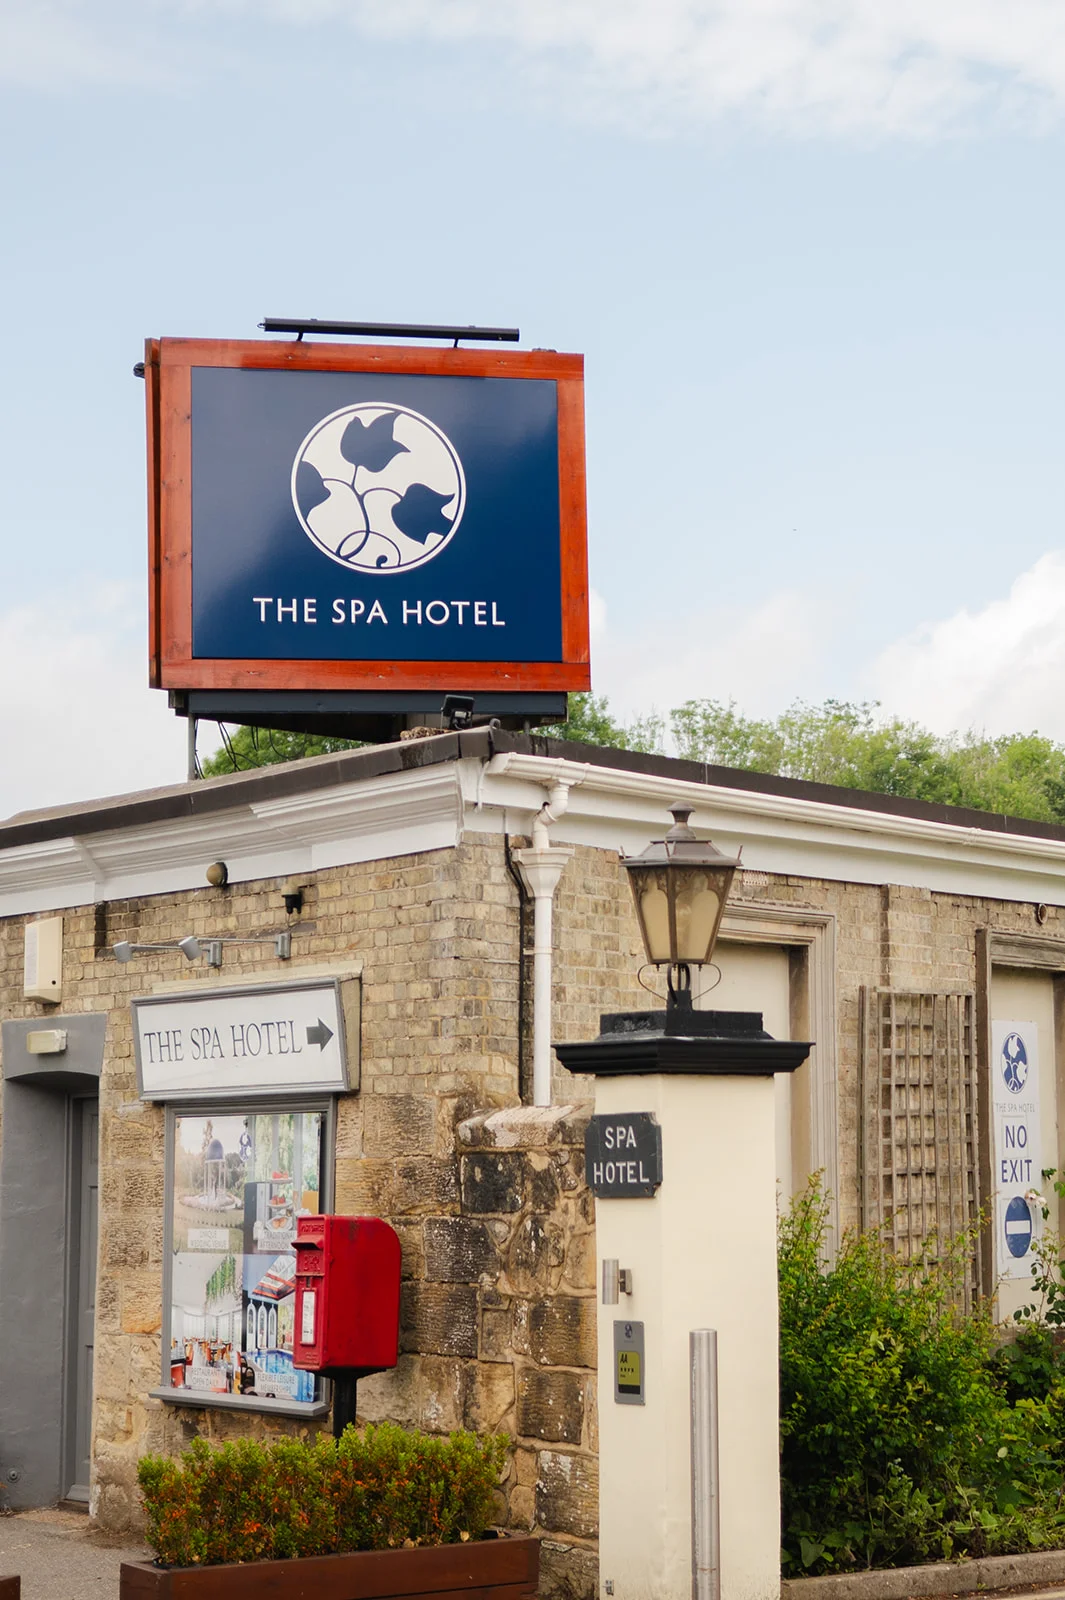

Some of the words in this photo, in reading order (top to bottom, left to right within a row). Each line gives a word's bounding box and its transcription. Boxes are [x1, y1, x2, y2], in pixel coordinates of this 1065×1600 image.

[253, 597, 317, 623] THE
[332, 598, 388, 625] SPA
[402, 600, 505, 626] HOTEL
[144, 1029, 184, 1063] THE
[190, 1026, 225, 1060] SPA
[230, 1020, 303, 1057] HOTEL
[996, 1103, 1006, 1112] THE
[1008, 1103, 1017, 1112] SPA
[1019, 1103, 1035, 1113] HOTEL
[604, 1125, 637, 1149] SPA
[1005, 1125, 1027, 1148] NO
[593, 1160, 650, 1184] HOTEL
[1001, 1159, 1033, 1183] EXIT
[190, 1240, 211, 1248] WEDDING
[212, 1240, 227, 1249] VENUE
[619, 1353, 628, 1364] AA
[191, 1367, 221, 1377] RESTAURANT
[192, 1376, 205, 1385] OPEN
[257, 1372, 276, 1382] FLEXIBLE
[277, 1374, 295, 1385] LEISURE
